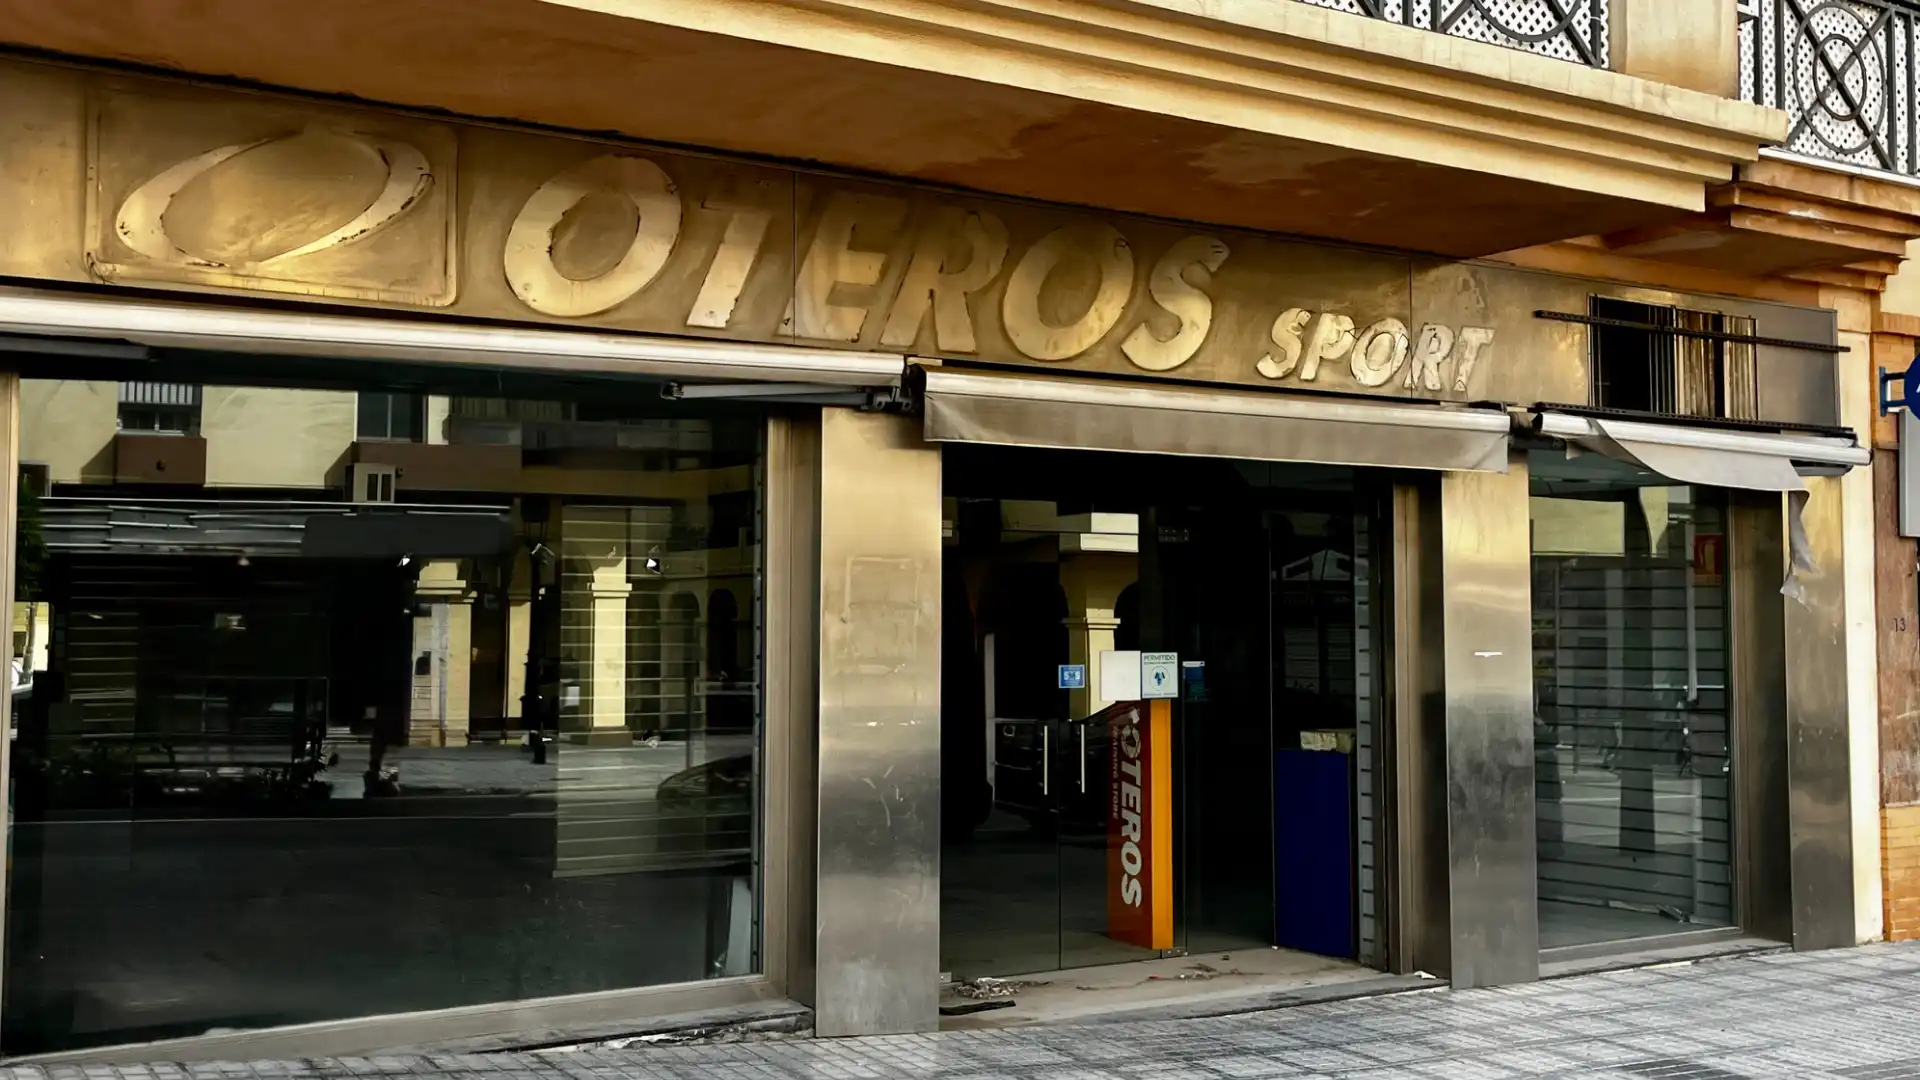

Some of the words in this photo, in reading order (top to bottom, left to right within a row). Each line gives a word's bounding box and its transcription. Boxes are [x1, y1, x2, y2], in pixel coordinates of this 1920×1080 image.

[503, 153, 1230, 371] OTEROS
[1256, 307, 1496, 391] SPORT
[1120, 724, 1143, 908] OTEROS
